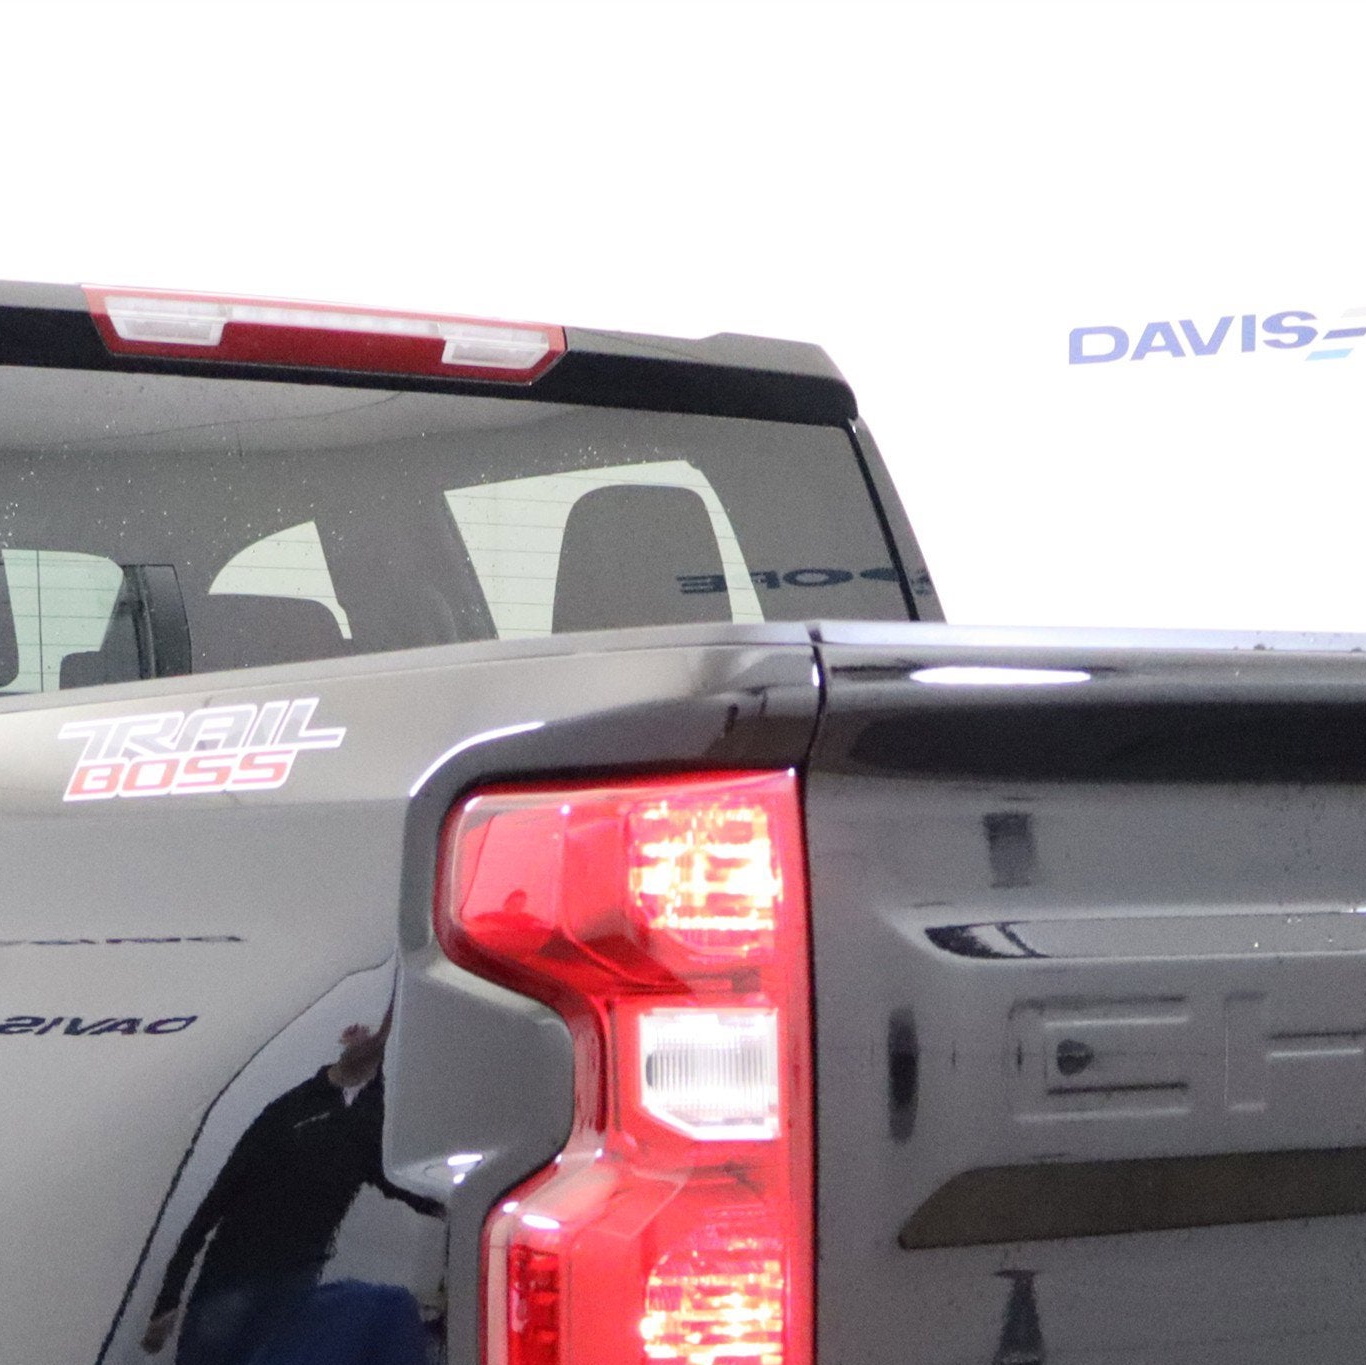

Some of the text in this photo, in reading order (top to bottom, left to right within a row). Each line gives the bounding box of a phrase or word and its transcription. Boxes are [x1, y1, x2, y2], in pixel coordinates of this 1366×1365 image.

[1069, 311, 1318, 364] DAVIS
[58, 697, 346, 762] TRAIL
[63, 749, 297, 801] BOSS
